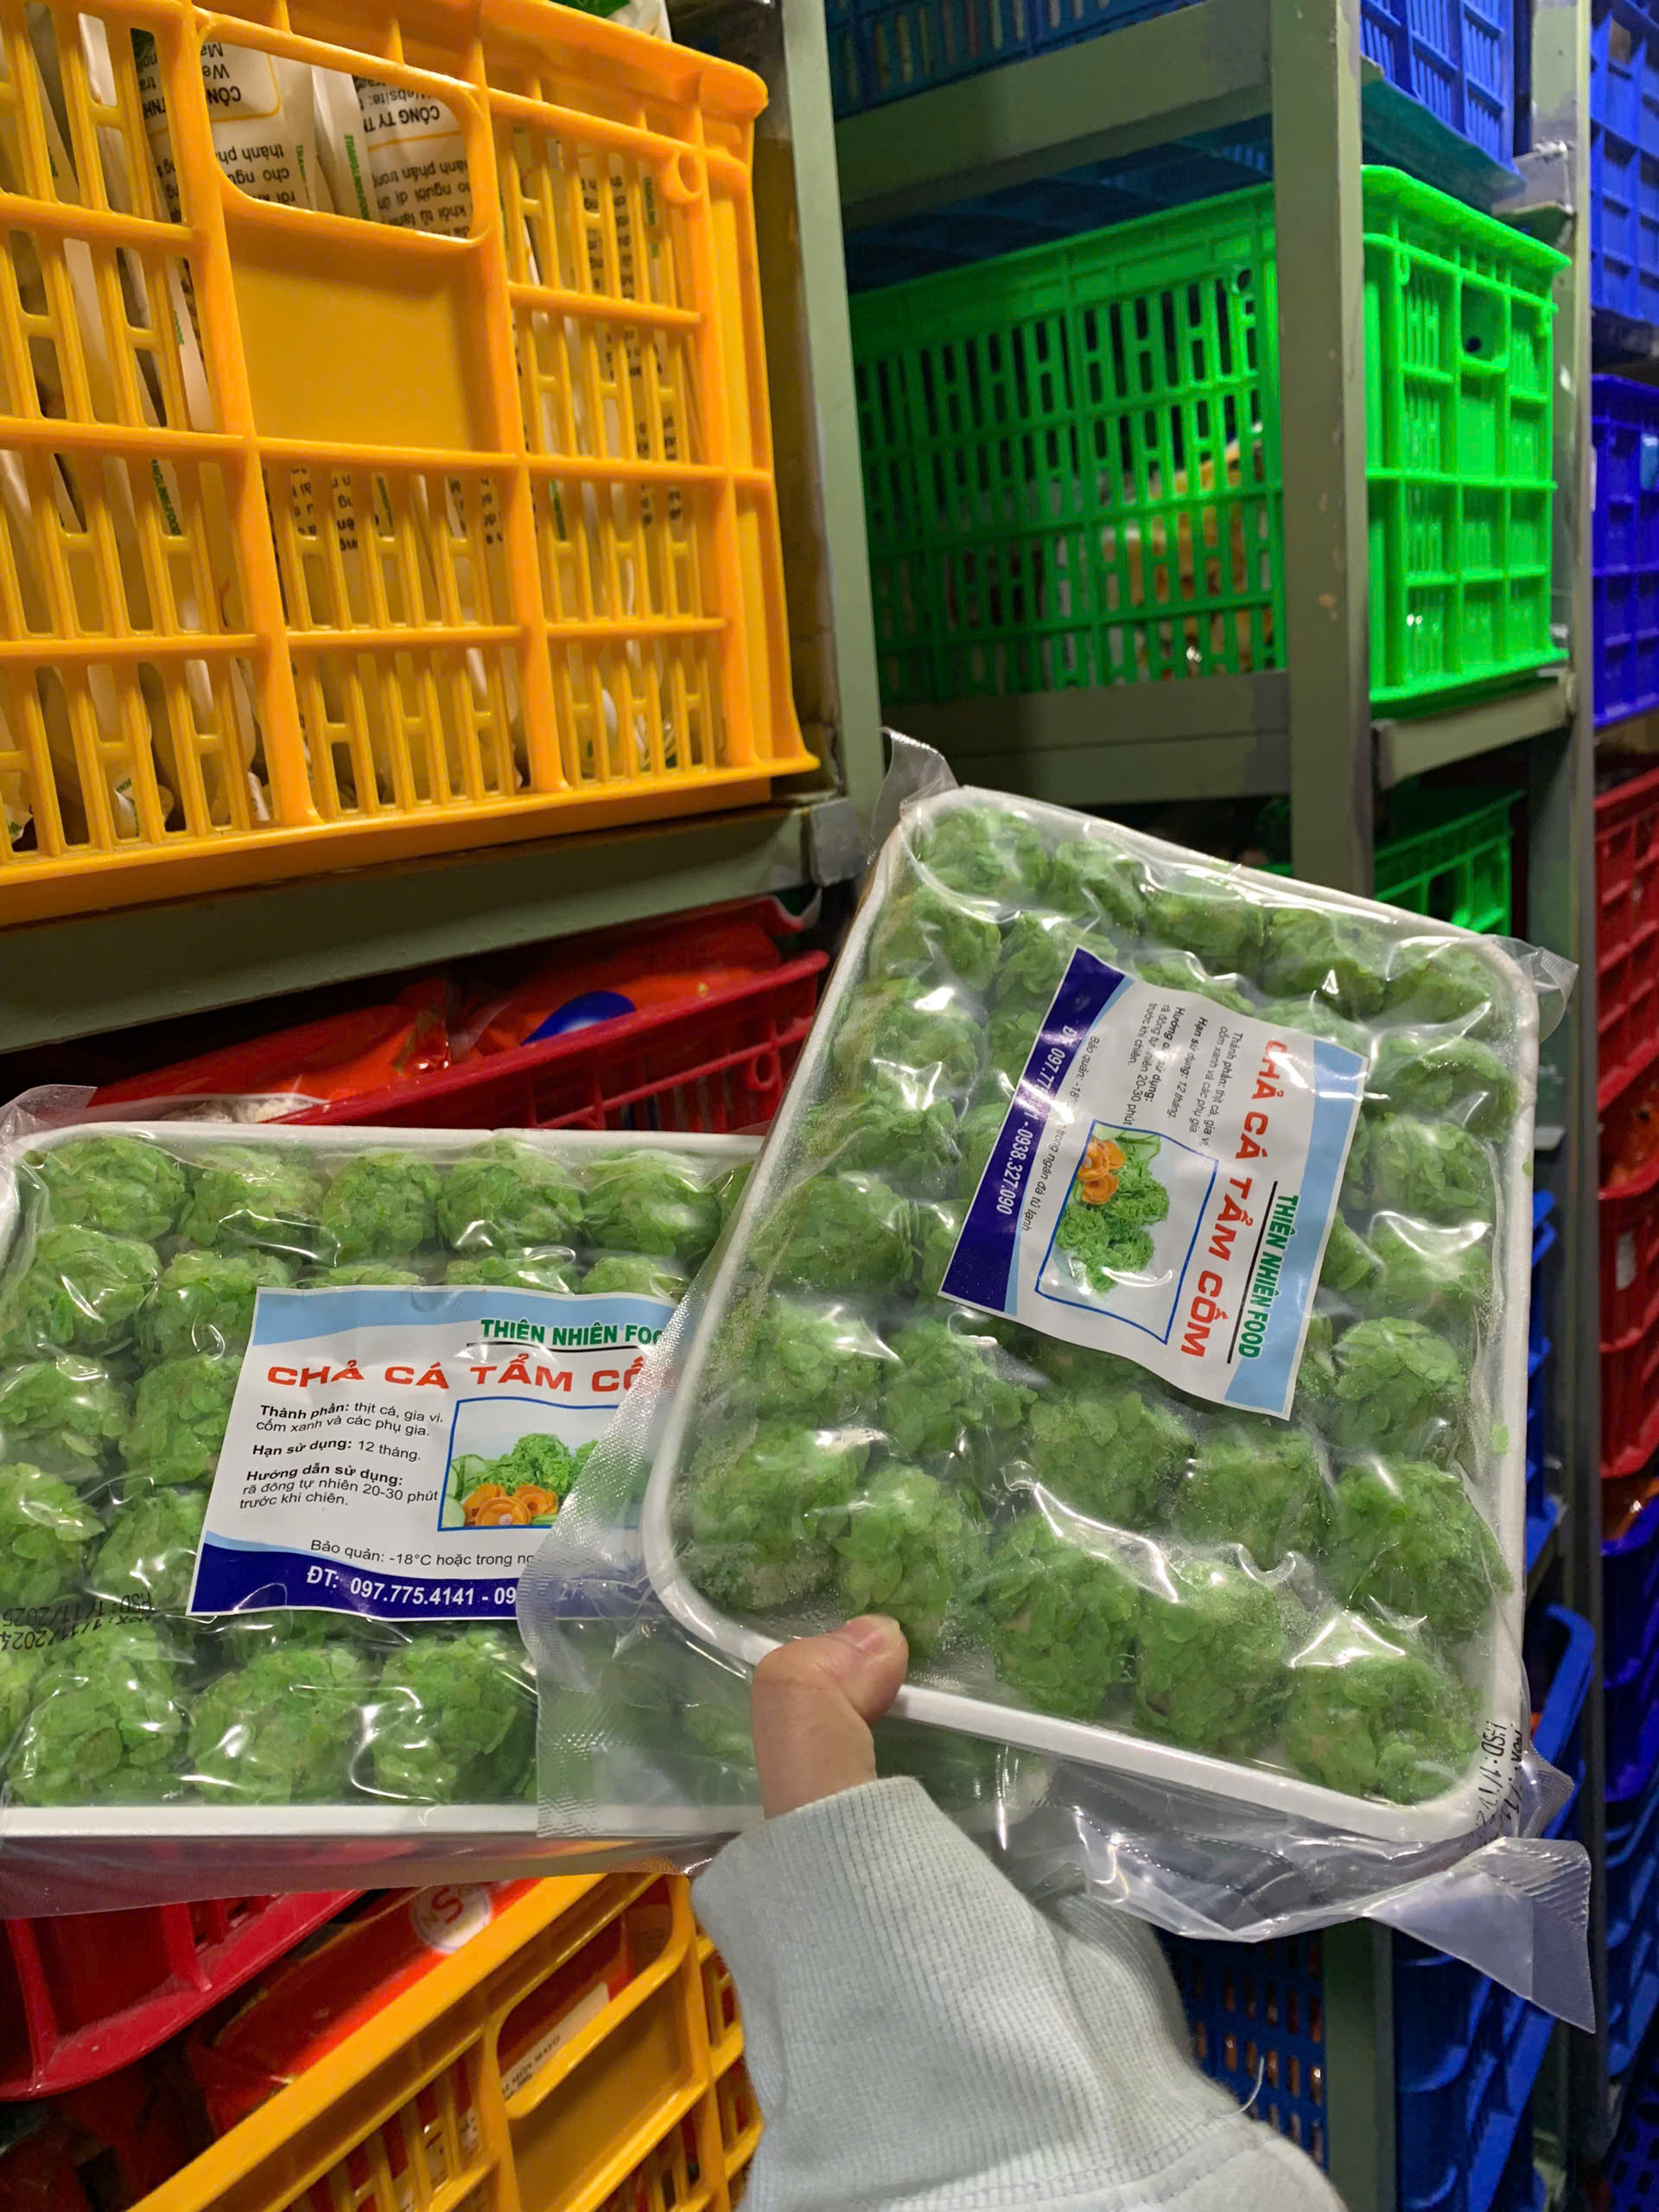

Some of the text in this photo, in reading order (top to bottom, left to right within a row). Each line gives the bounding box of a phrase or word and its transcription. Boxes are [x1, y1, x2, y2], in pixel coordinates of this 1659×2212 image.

[263, 168, 290, 182] cho
[1130, 1073, 1148, 1103] 20-30
[1235, 1111, 1269, 1160] CÁ
[996, 1127, 1034, 1216] 0938.327.090
[1208, 1176, 1255, 1262] TẨM
[1237, 1193, 1300, 1359] THIÊN NHIÊN FOOD
[1180, 1270, 1229, 1358] CỐM
[480, 1319, 545, 1344] THIÊN
[552, 1321, 618, 1346] NHIÊN
[267, 1359, 365, 1388] CHẢ
[384, 1361, 450, 1389] CÁ
[469, 1352, 573, 1393] TẨM
[256, 1414, 430, 1436] cốm xanh và các phụ gia.
[259, 1404, 307, 1420] Thành
[309, 1402, 350, 1420] phần:
[353, 1402, 376, 1414] thịt
[379, 1405, 400, 1419] cá,
[404, 1410, 425, 1422] gia
[252, 1439, 422, 1463] Hạn sử dụng: 12 tháng.
[245, 1461, 404, 1487] Hướng dẫn sử dụng:
[238, 1491, 349, 1510] trước khi chiên.
[242, 1478, 439, 1504] rã đông tự nhiên 20-30 phút
[310, 1539, 341, 1554] Bảo
[344, 1545, 385, 1563] quản:
[388, 1554, 432, 1567] -18°C
[435, 1553, 473, 1567] hoặc
[475, 1554, 514, 1568] trong
[307, 1565, 340, 1590] ĐT:
[349, 1577, 475, 1606] 097.775.4141
